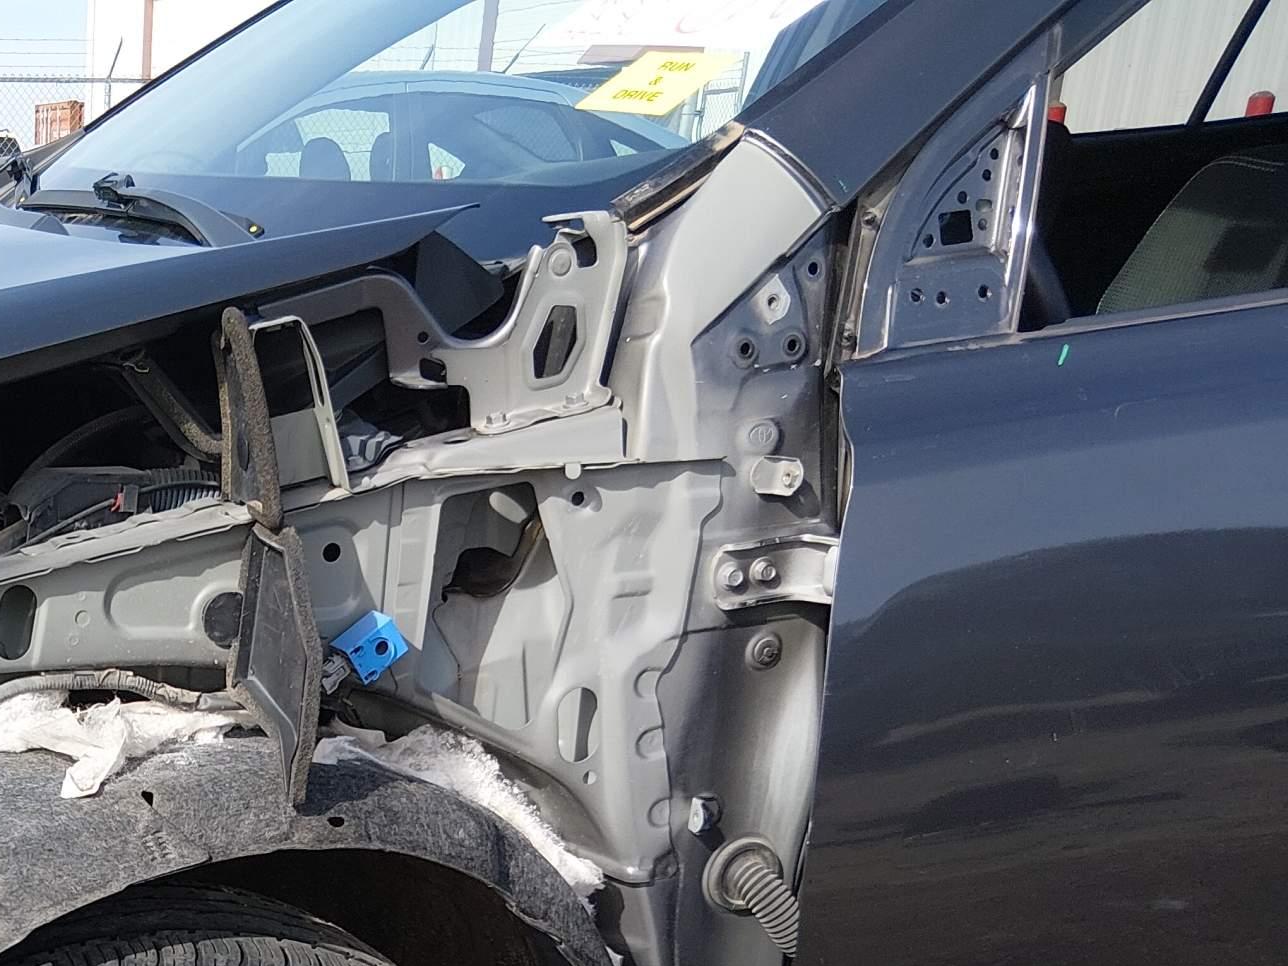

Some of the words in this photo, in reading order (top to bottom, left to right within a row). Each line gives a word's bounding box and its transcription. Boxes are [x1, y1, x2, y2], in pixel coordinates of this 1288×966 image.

[658, 61, 697, 72] RUN
[648, 76, 664, 86] &
[612, 89, 665, 102] DRIVE
